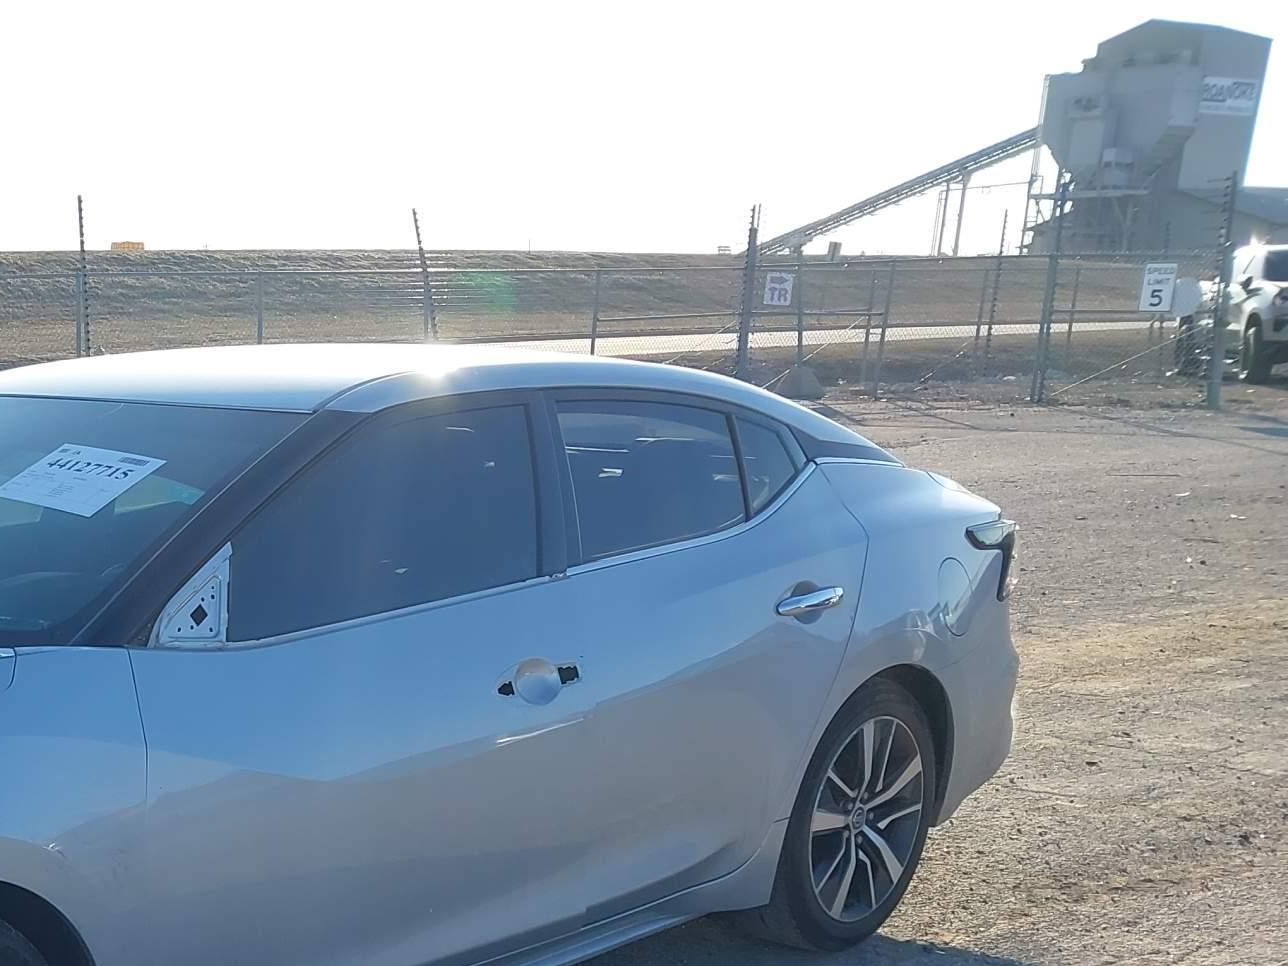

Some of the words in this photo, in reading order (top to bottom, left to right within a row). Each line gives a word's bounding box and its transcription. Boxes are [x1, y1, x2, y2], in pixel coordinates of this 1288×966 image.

[1147, 266, 1175, 275] SPEED
[1147, 277, 1171, 286] LIMIT
[767, 286, 789, 303] TR
[1148, 289, 1163, 307] 5
[47, 457, 136, 481] 44127715
